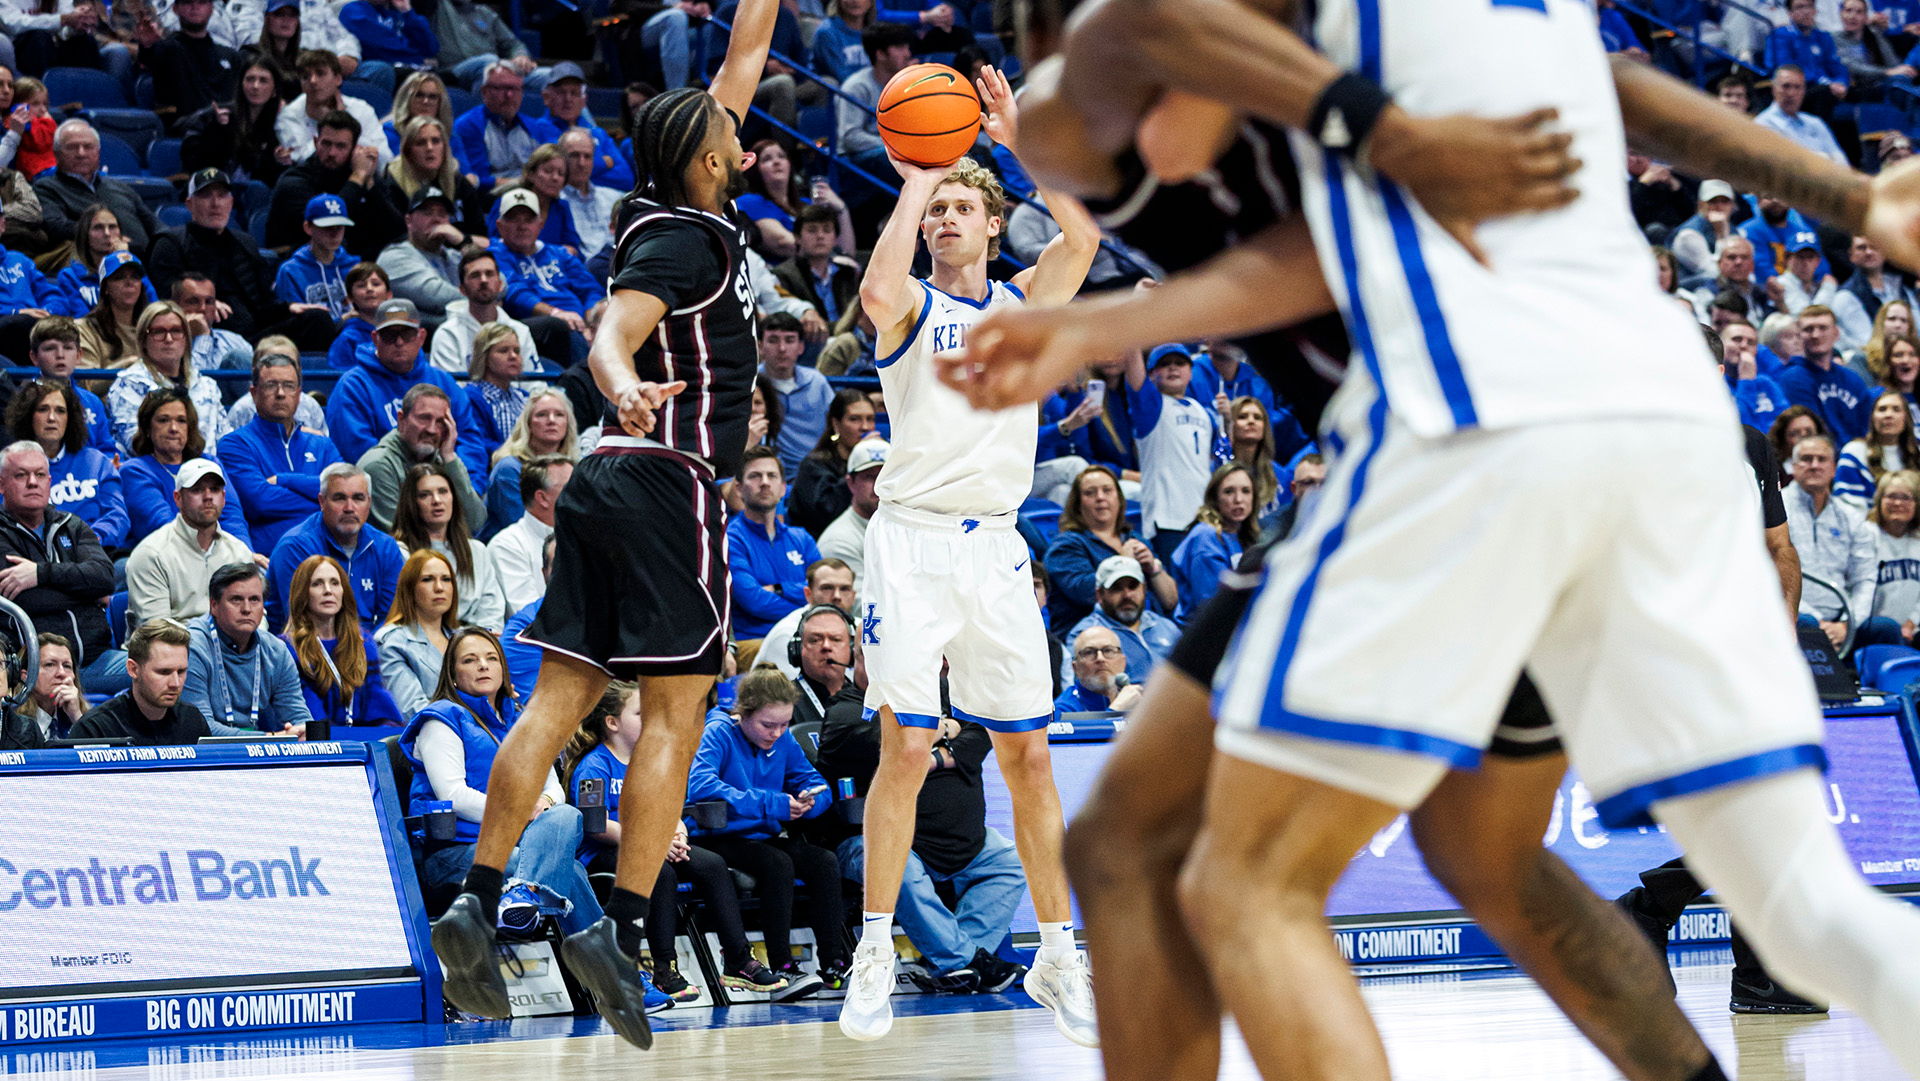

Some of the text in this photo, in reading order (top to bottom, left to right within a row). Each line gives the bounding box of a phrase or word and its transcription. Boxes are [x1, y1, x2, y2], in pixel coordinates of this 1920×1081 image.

[361, 578, 374, 591] UK
[77, 746, 196, 763] KENTUCKY FARM BUREAU
[245, 742, 342, 757] BIG ON COMMITMENT
[187, 846, 330, 902] Bank
[1861, 860, 1904, 873] Member
[1358, 928, 1462, 959] COMMITMENT
[50, 951, 132, 967] Member FDIC
[147, 991, 356, 1030] BIG ON COMMITMENT
[15, 1005, 95, 1039] BUREAU
